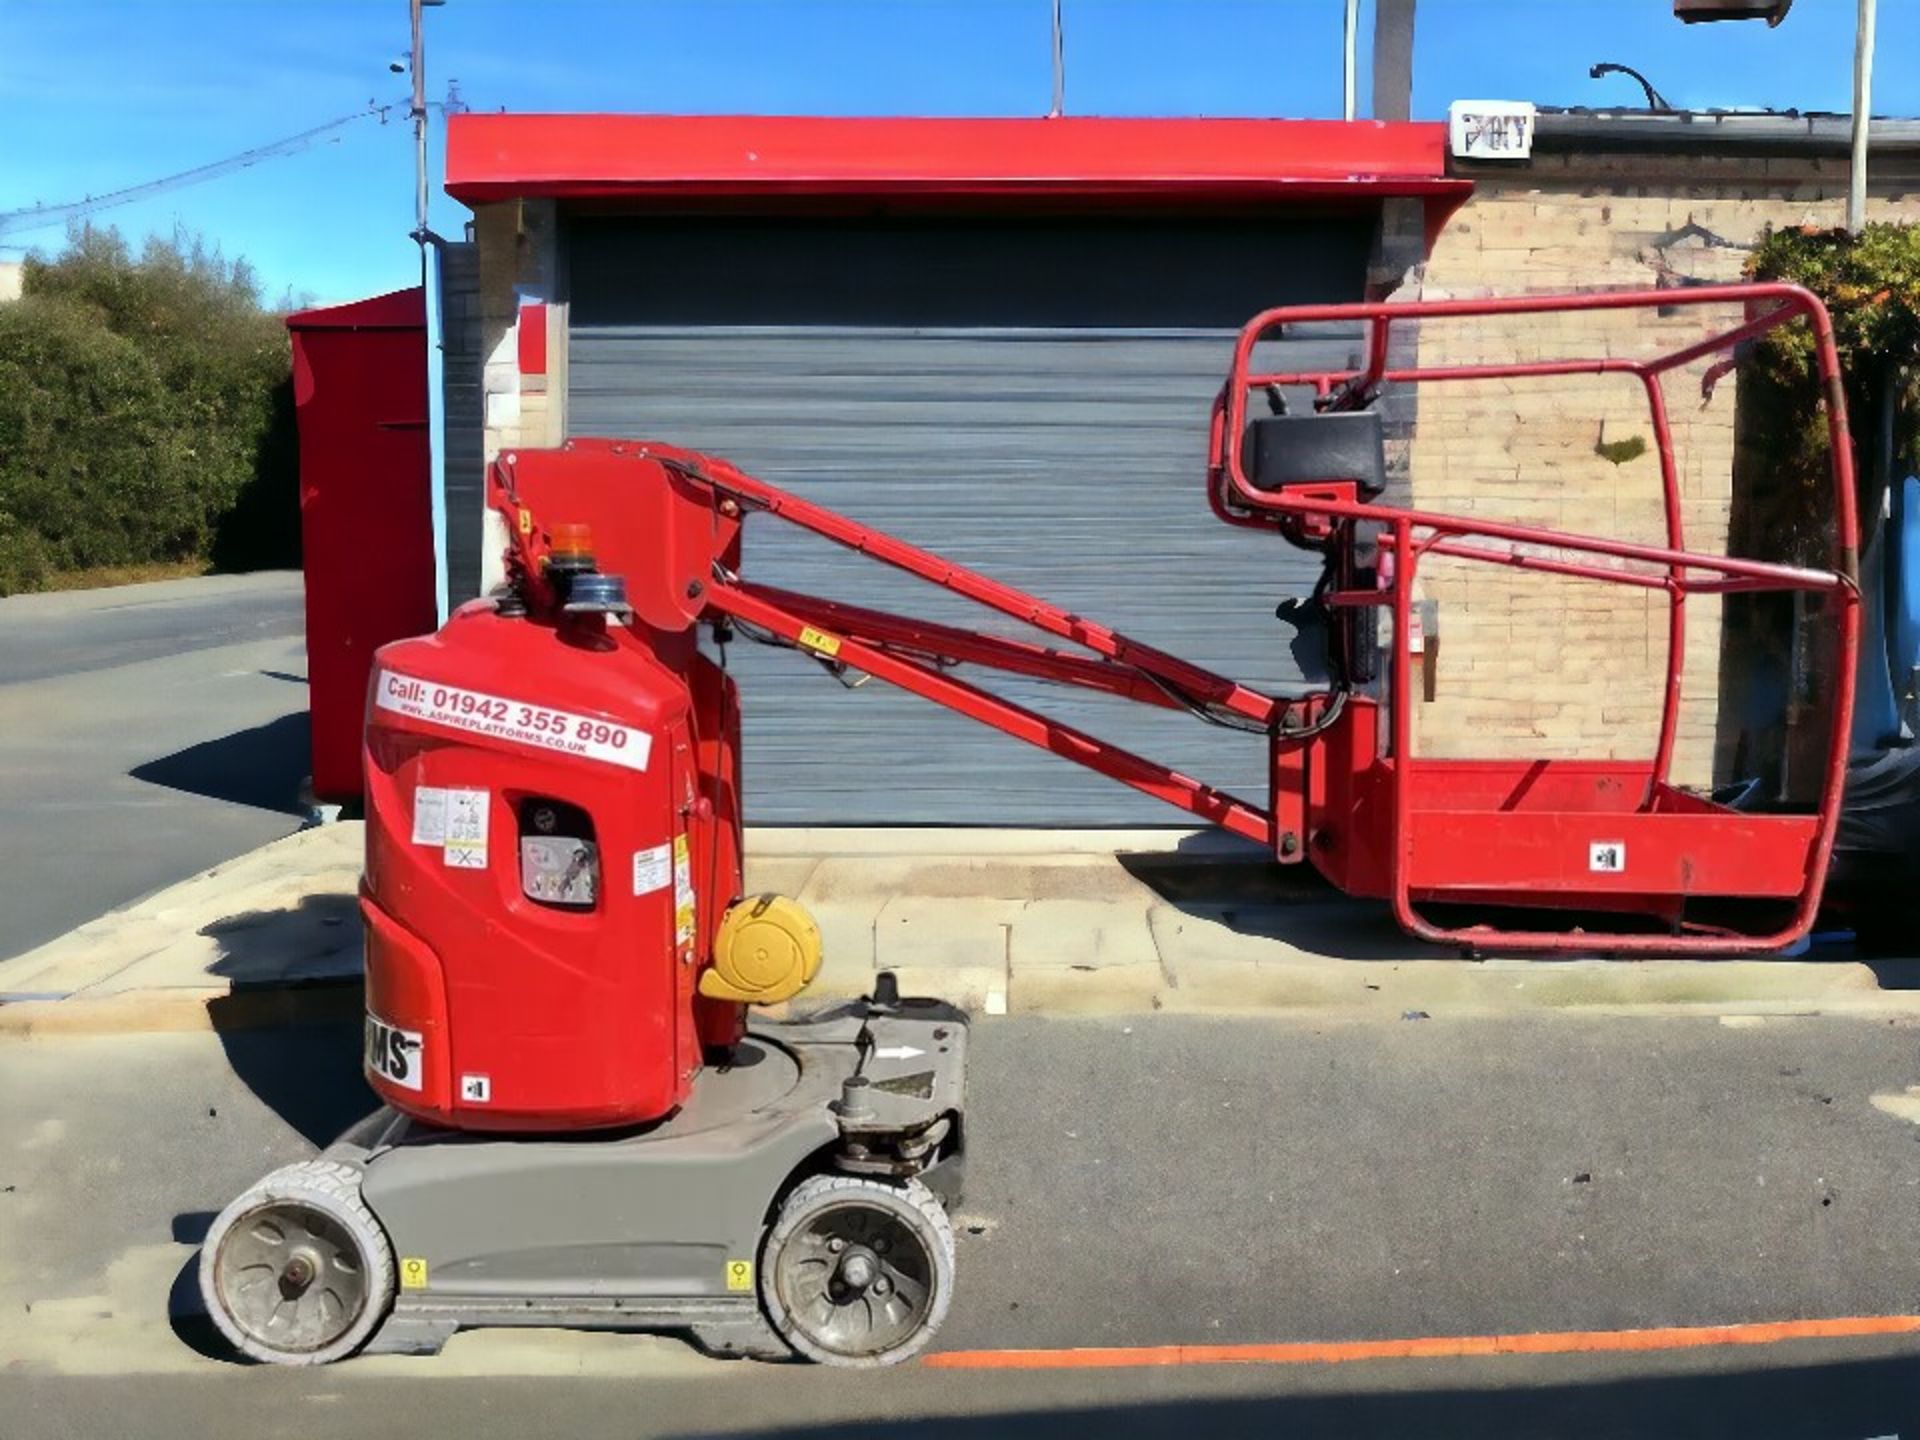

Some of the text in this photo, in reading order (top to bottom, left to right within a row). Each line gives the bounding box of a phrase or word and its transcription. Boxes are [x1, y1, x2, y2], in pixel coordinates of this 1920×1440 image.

[387, 677, 628, 749] Call: 01942 355 890
